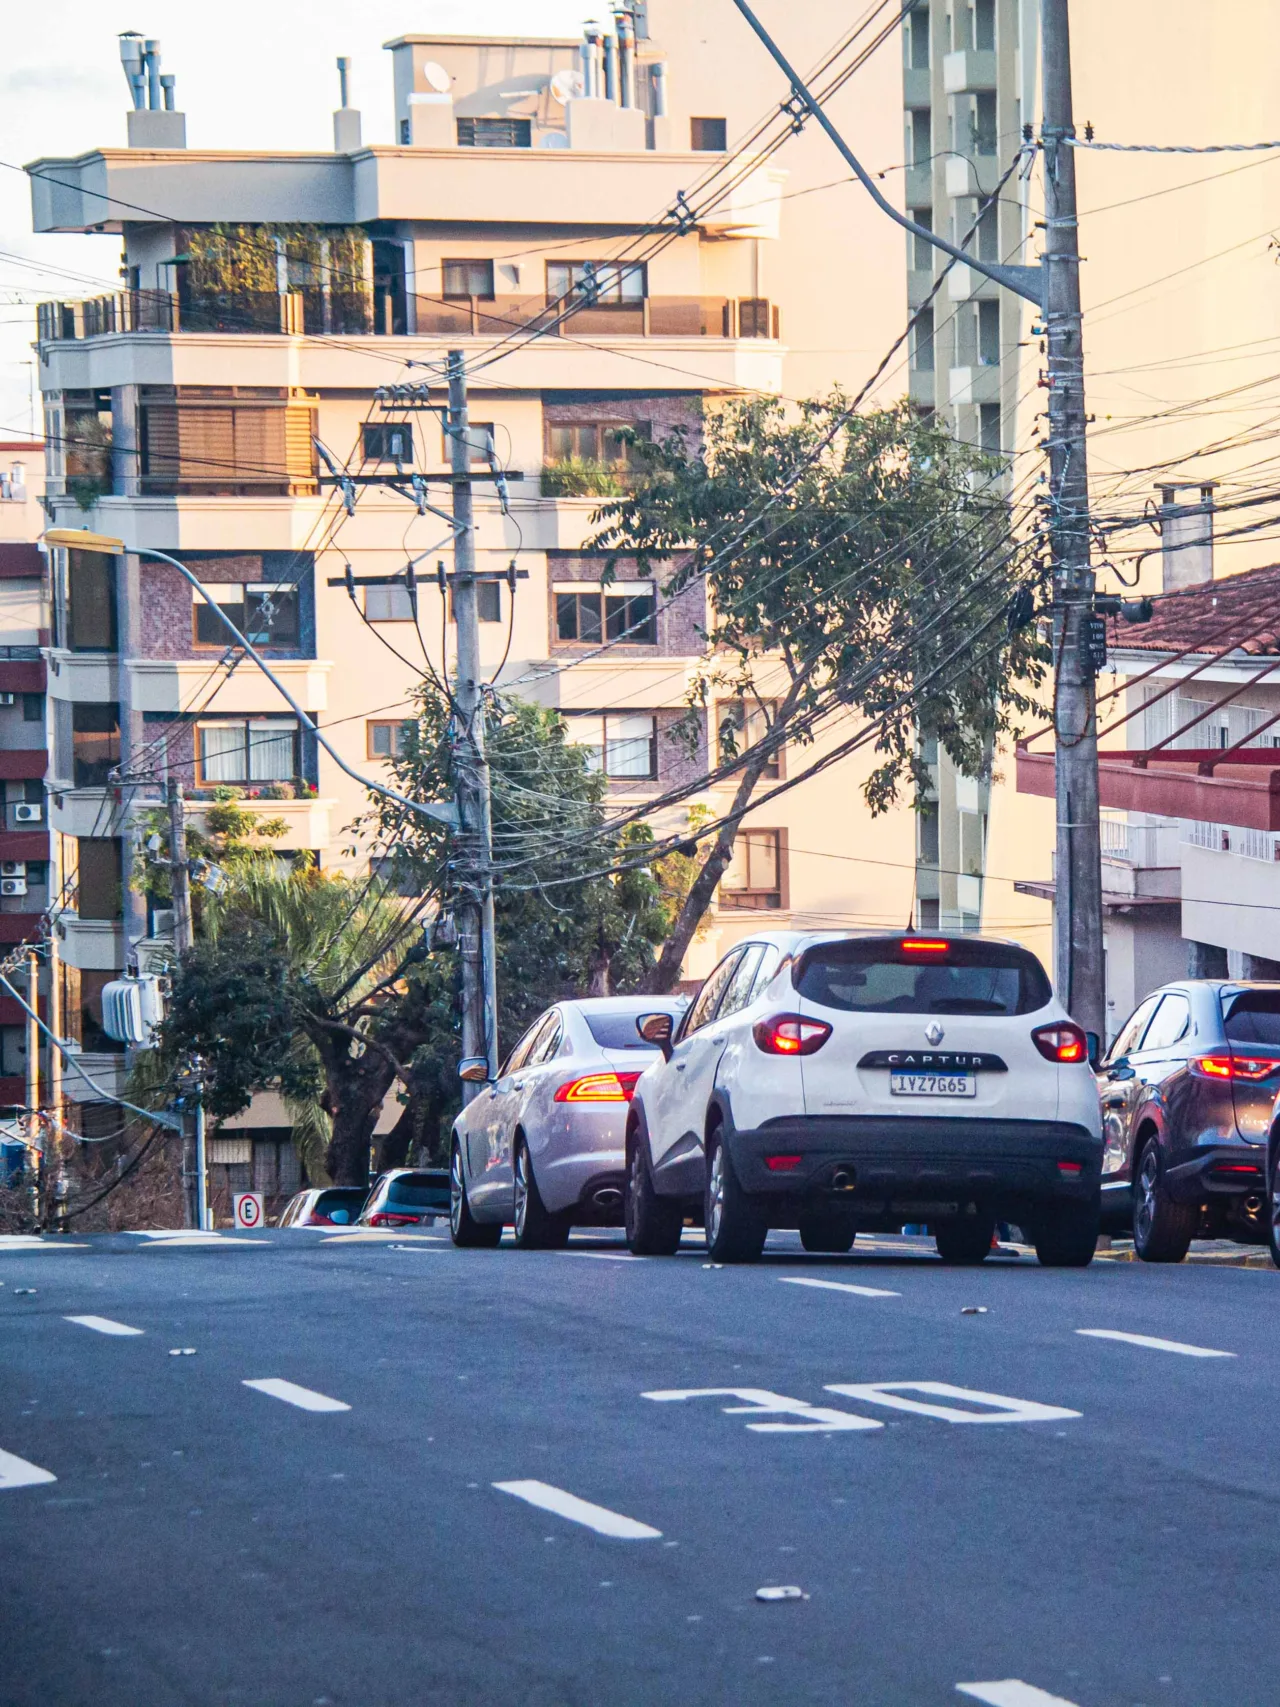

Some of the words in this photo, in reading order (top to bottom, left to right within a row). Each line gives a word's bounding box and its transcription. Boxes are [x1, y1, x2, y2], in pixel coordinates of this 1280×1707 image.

[888, 1054, 982, 1065] CAPTUR
[245, 1202, 252, 1219] E
[641, 1381, 1084, 1433] 30
